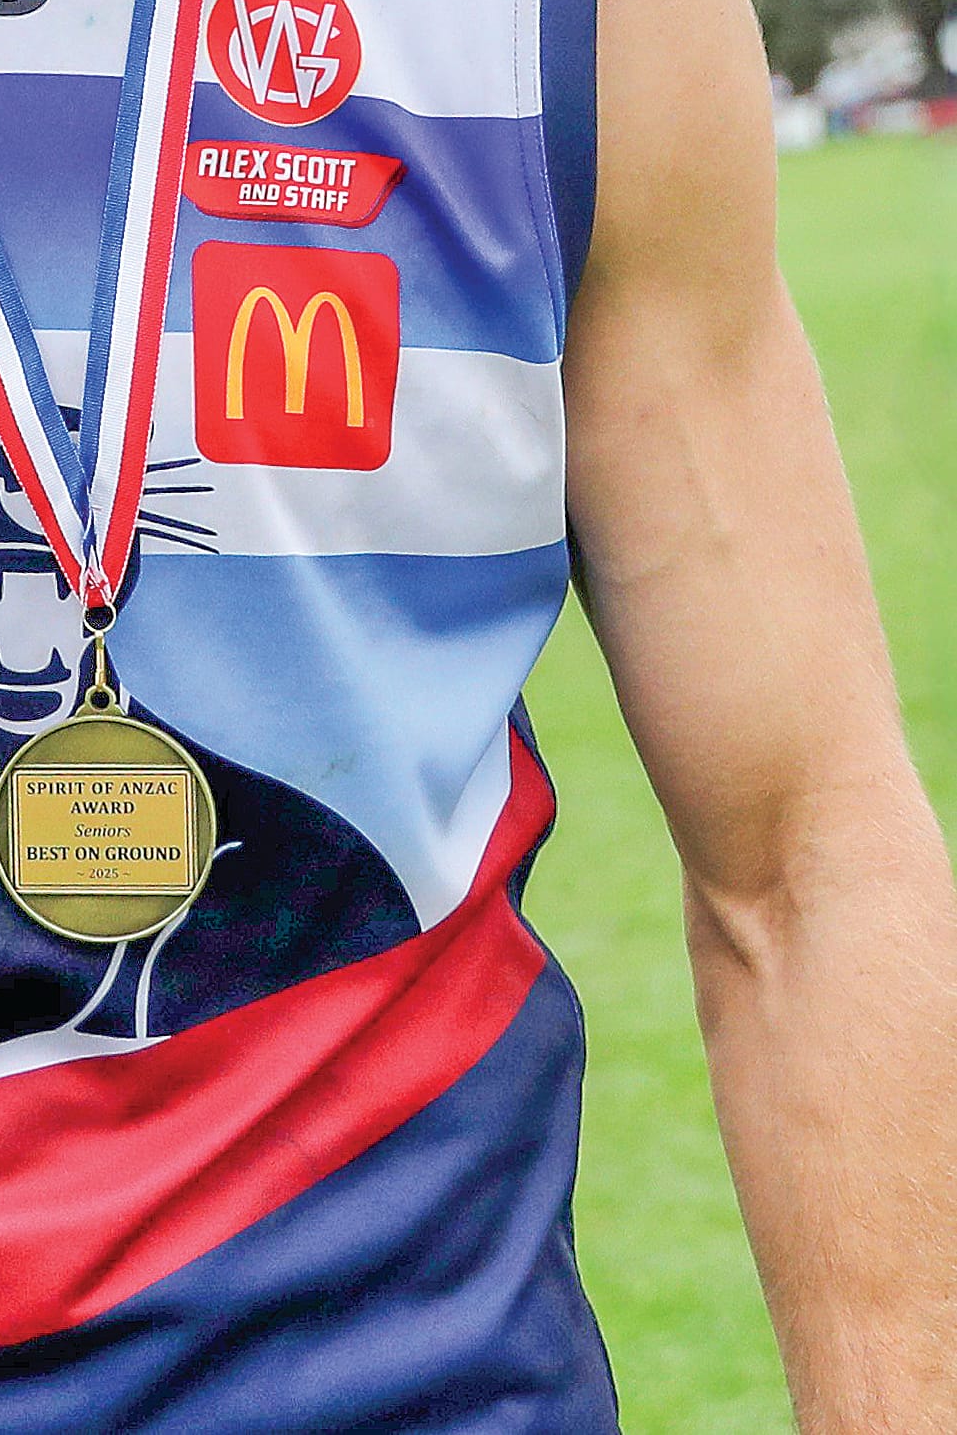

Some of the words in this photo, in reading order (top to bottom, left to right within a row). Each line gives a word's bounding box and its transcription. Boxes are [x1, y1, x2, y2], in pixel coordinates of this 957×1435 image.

[198, 148, 269, 179] ALEX
[274, 152, 356, 187] SCOTT
[241, 184, 280, 201] AND
[284, 188, 348, 211] STAFF
[27, 782, 85, 795] SPIRIT
[92, 782, 115, 795] OF
[120, 782, 178, 795] ANZAC
[71, 801, 135, 815] AWARD
[74, 823, 131, 838] Seniors
[27, 846, 70, 861] BEST
[75, 846, 100, 861] ON
[105, 846, 181, 861] GROUND
[89, 868, 119, 879] 2025
